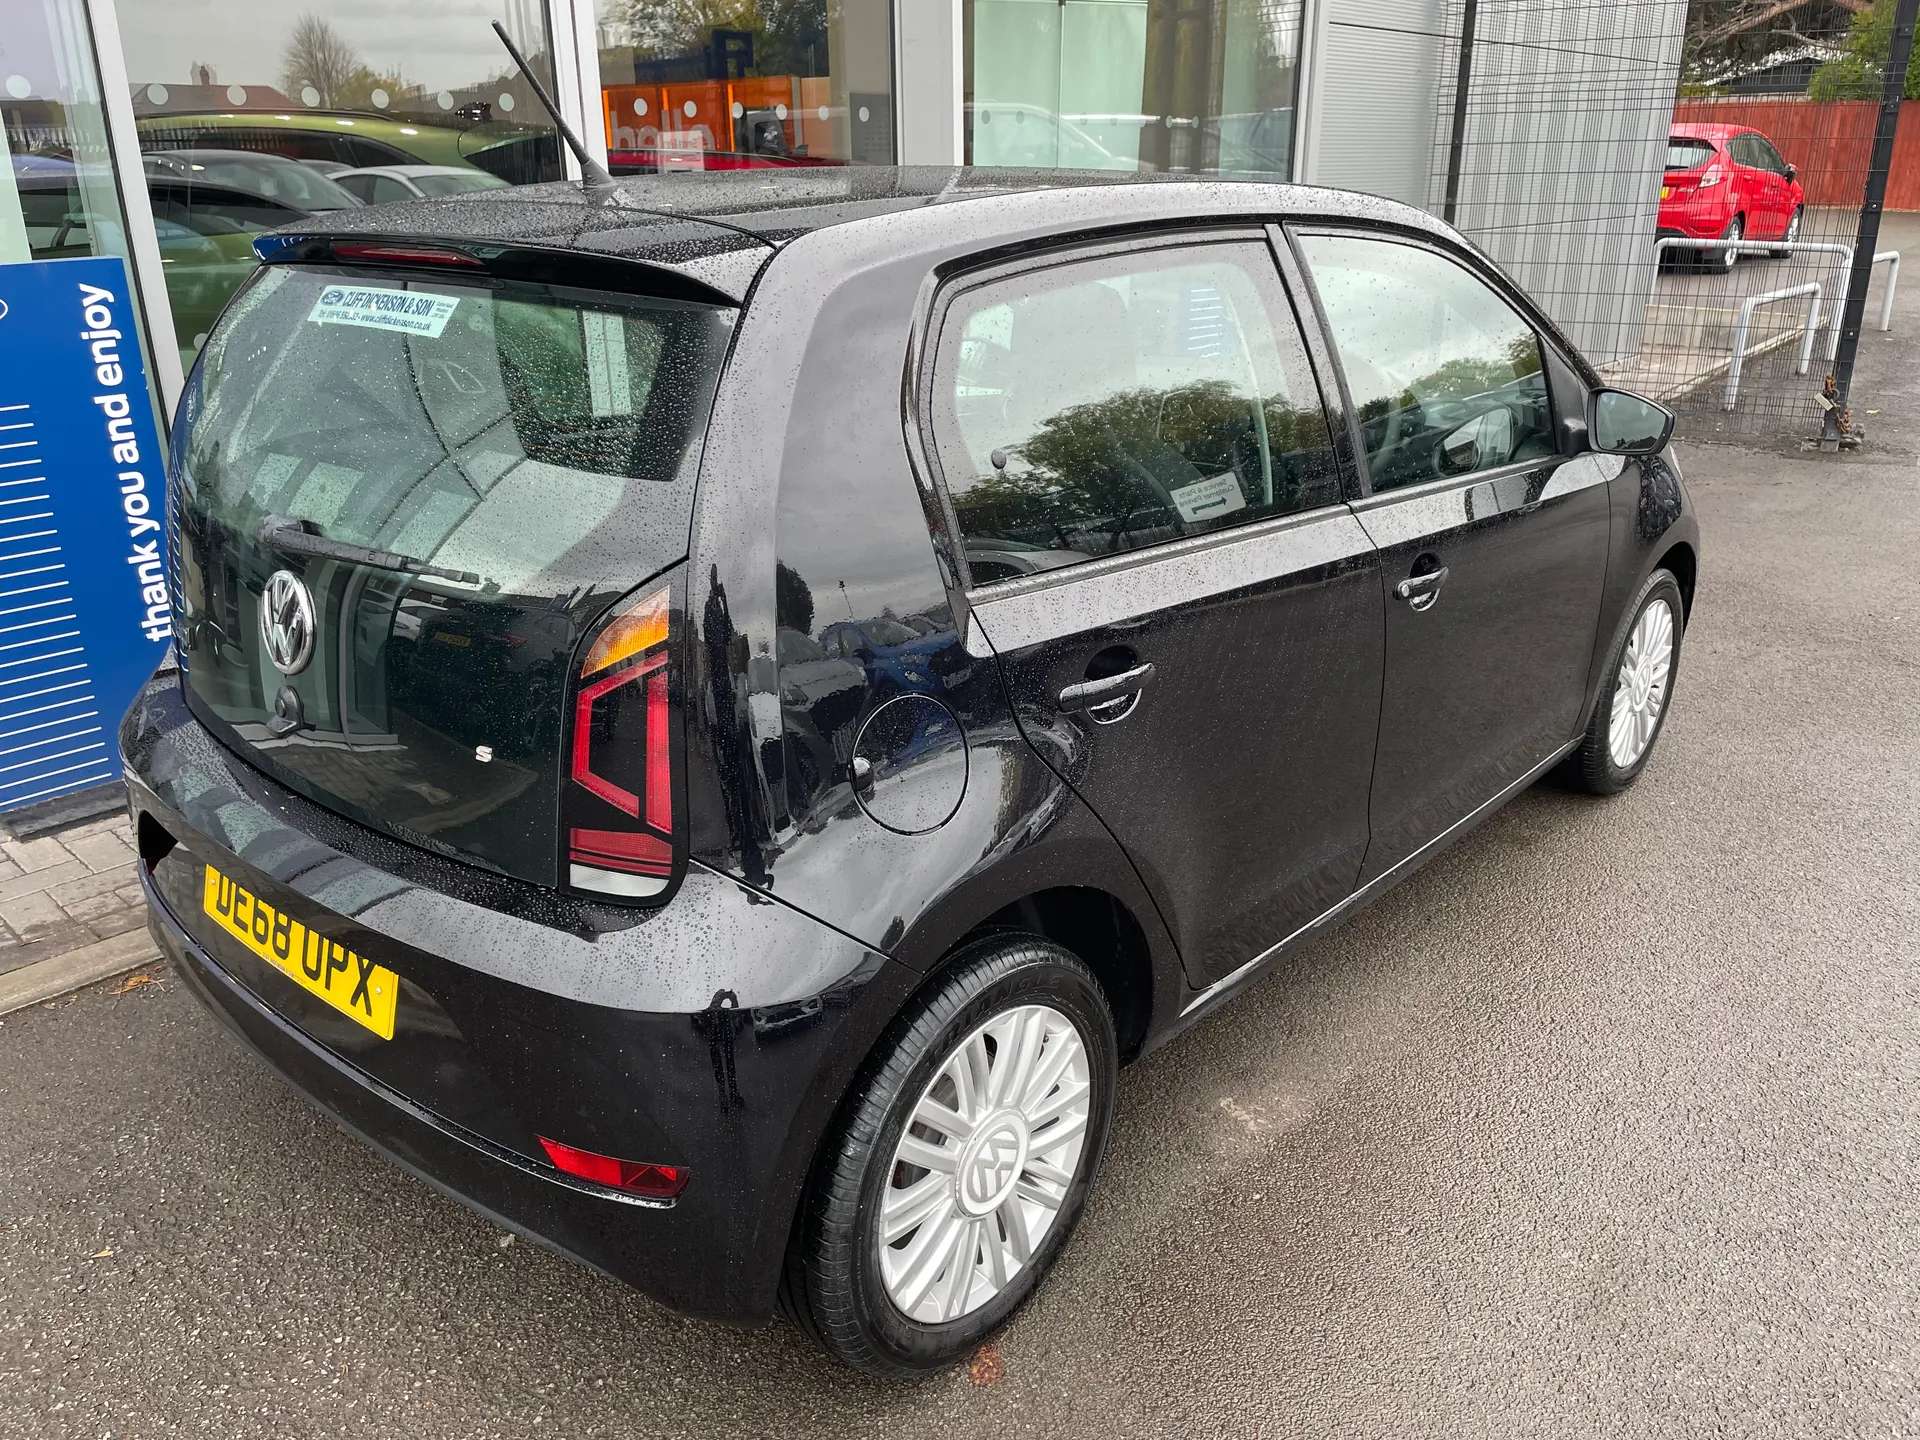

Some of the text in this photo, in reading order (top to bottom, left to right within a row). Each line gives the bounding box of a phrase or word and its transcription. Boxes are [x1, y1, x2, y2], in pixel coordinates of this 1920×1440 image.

[342, 291, 365, 308] CLIFF
[411, 298, 436, 317] SON
[79, 282, 172, 643] thank you and enjoy
[216, 873, 292, 960] DE68
